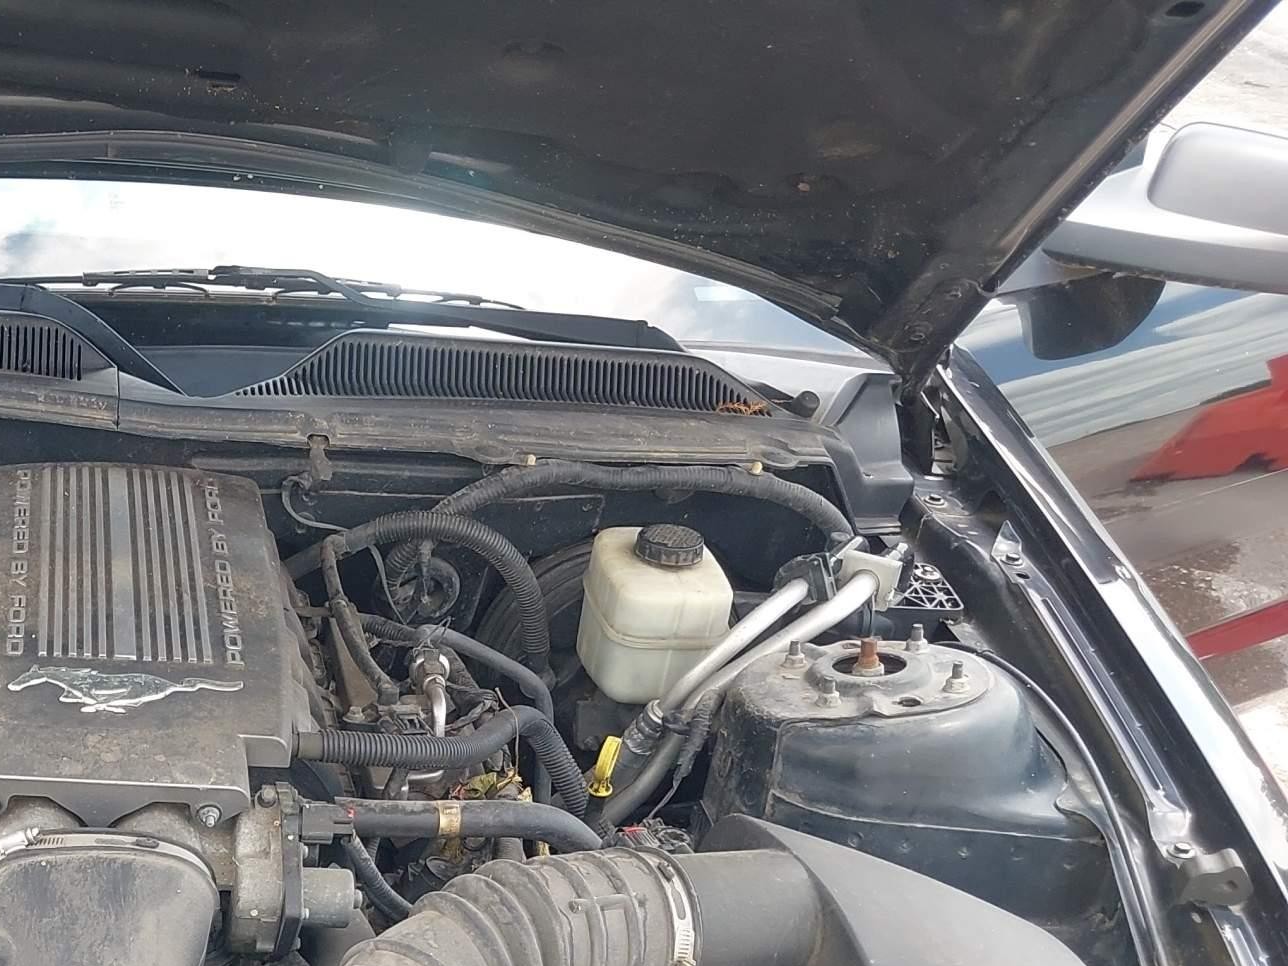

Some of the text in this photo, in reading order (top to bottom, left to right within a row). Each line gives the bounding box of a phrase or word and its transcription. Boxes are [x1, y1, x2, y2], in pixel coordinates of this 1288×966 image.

[7, 469, 31, 655] POWERED BY FORD
[205, 478, 244, 666] POWERED BY FORD
